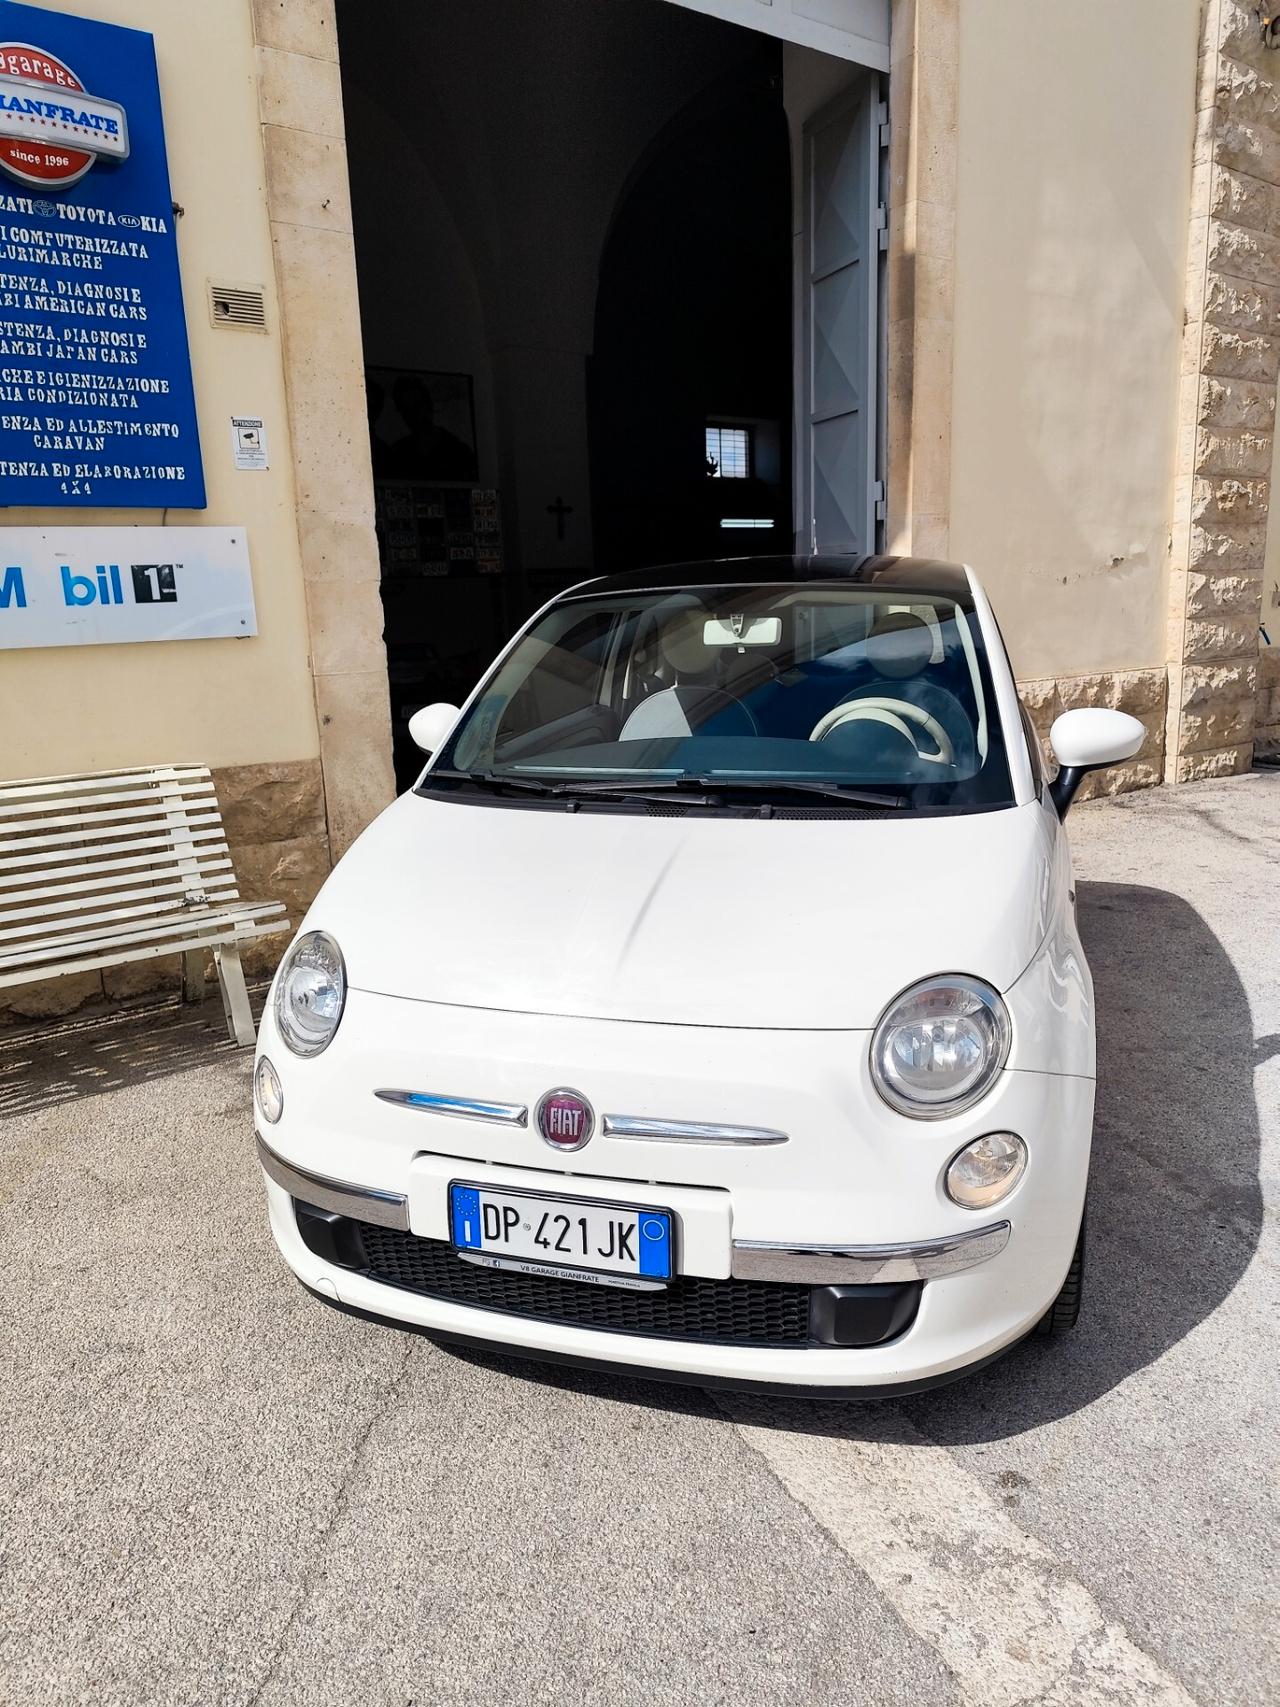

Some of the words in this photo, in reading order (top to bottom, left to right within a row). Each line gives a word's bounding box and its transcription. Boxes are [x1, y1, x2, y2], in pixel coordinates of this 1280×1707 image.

[10, 149, 40, 165] since
[45, 154, 69, 166] 1996
[56, 203, 117, 226] TOYOTA
[140, 216, 168, 233] KIA
[10, 227, 149, 259] COMPUTERIZZATA
[0, 292, 20, 308] BI
[24, 294, 106, 317] AMERICAN
[109, 303, 148, 320] CARS
[0, 340, 42, 356] AMBI
[46, 344, 97, 361] JAPAN
[101, 348, 138, 364] CARS
[0, 368, 33, 384] CHE
[36, 371, 46, 385] E
[48, 372, 169, 393] IGIENIZZAZIONE
[27, 387, 139, 408] CONDIZIONATA
[1, 415, 42, 431] ENZA
[45, 417, 64, 431] ED
[33, 434, 105, 451] CARAVAN
[52, 462, 70, 477] ED
[550, 1107, 582, 1136] FIAT
[483, 1203, 520, 1243] DP
[531, 1266, 559, 1277] GARAGE
[560, 1271, 600, 1283] GIANFRATE
